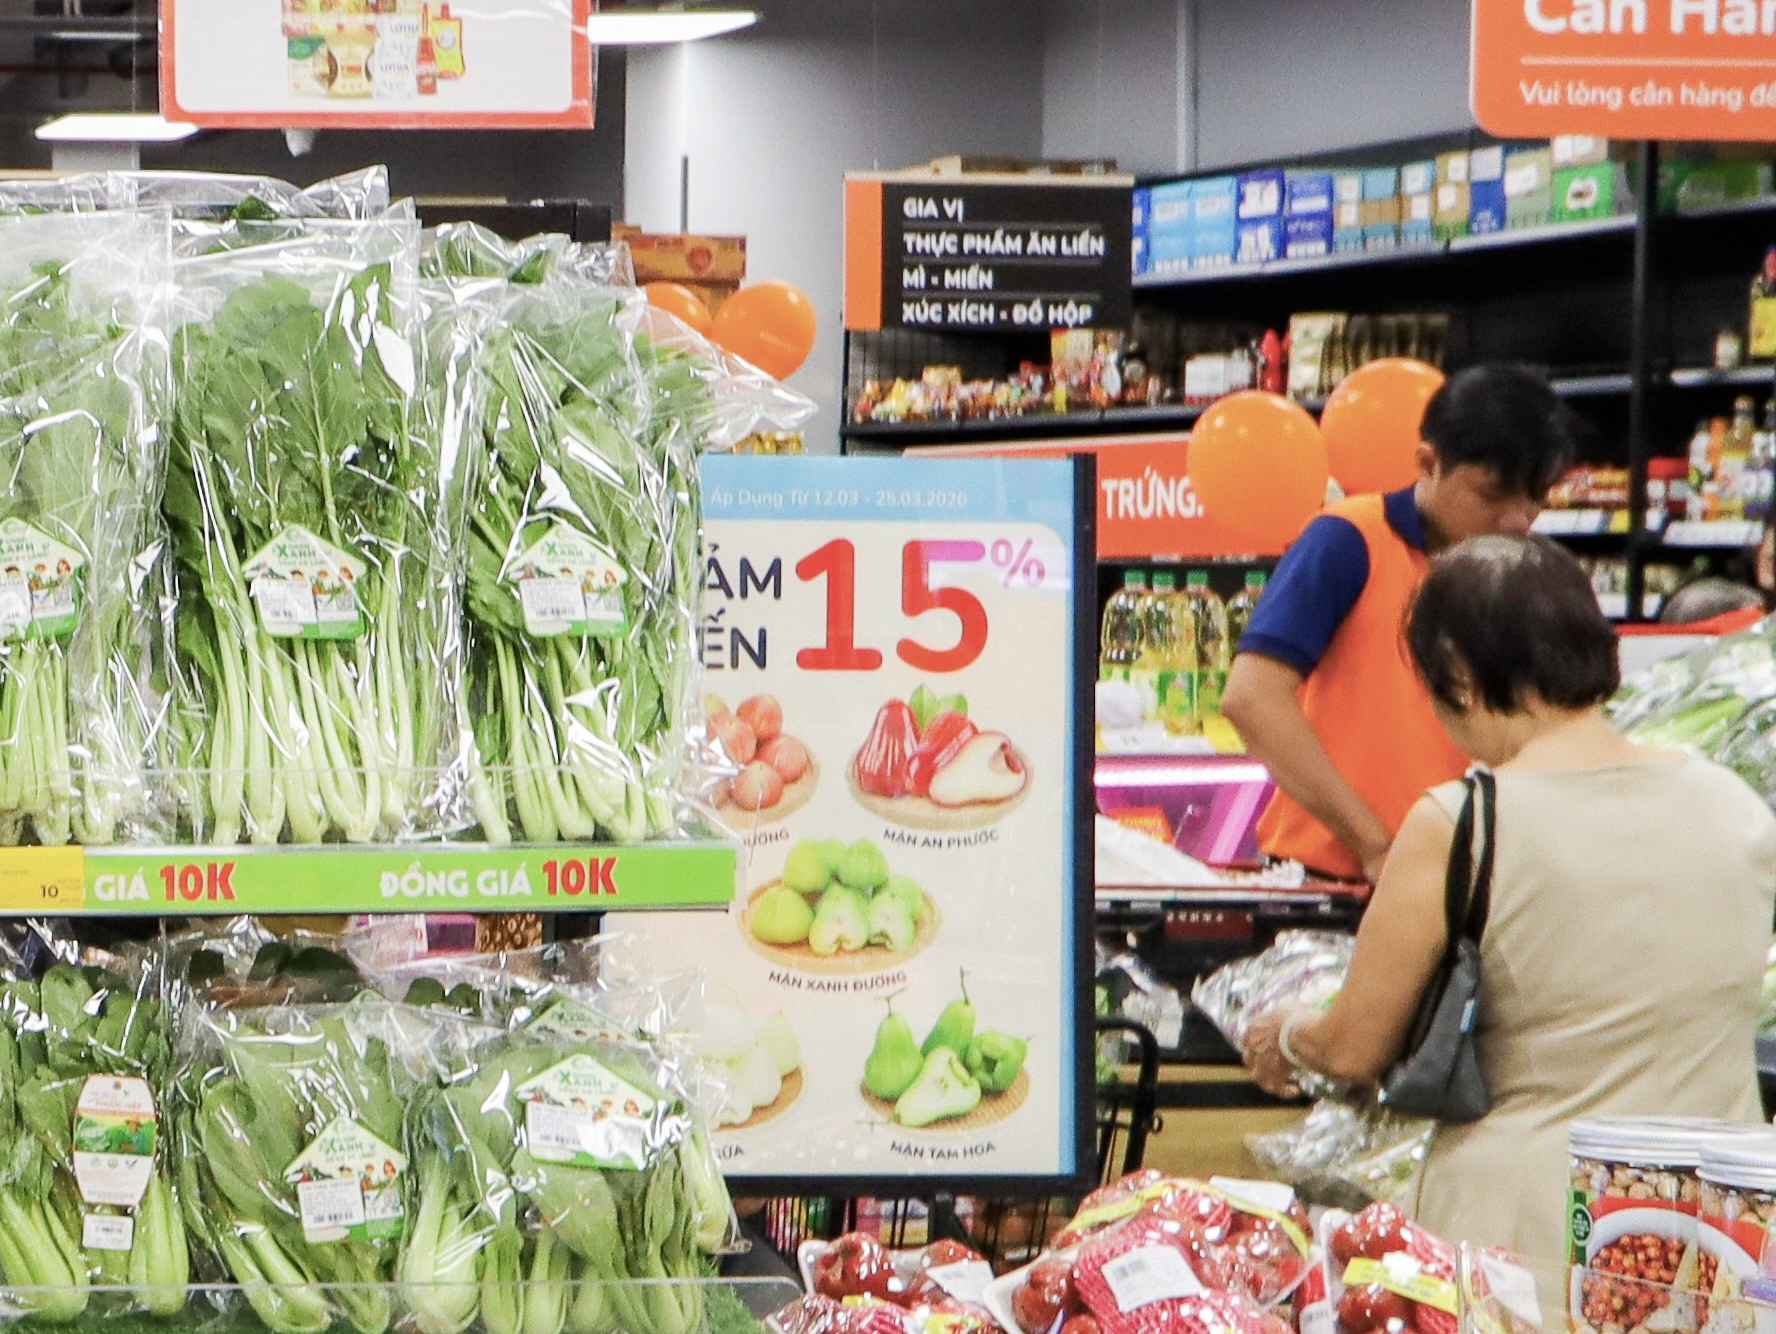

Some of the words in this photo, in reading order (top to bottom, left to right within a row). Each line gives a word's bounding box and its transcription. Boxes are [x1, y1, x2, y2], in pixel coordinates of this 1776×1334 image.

[1519, 78, 1561, 107] Vui
[1567, 79, 1624, 113] lòng
[902, 196, 939, 219] GIA
[795, 537, 1046, 674] 15%
[921, 836, 943, 849] AN
[93, 864, 150, 901] GIÁ
[159, 861, 236, 902] 10K
[380, 860, 470, 900] ĐỒNG
[477, 860, 532, 898] GIÁ
[542, 857, 618, 896] 10K
[807, 979, 849, 993] XANH
[928, 1146, 959, 1161] TAM
[963, 1142, 996, 1159] HOA
